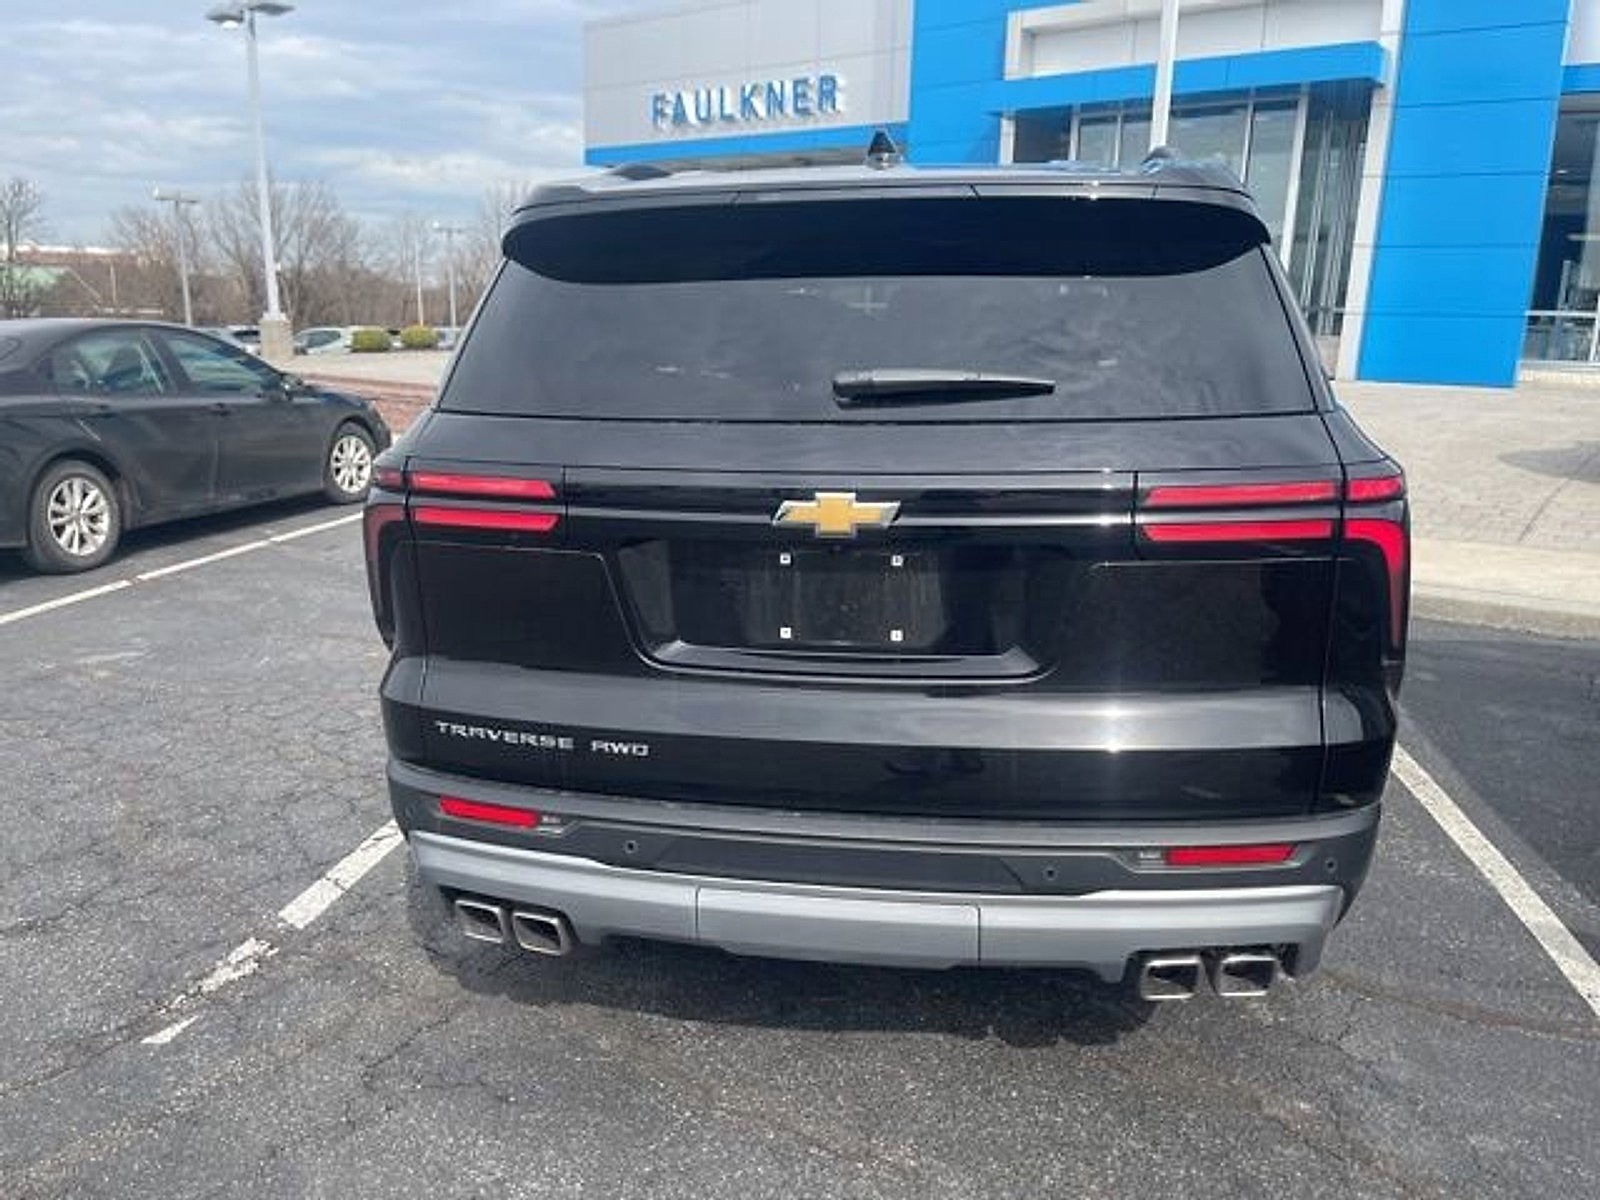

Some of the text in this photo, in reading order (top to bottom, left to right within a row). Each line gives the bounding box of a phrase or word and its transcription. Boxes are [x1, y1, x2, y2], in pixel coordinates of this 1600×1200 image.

[651, 74, 840, 127] FAULKNER
[435, 720, 650, 757] TRAVERSE AWD
